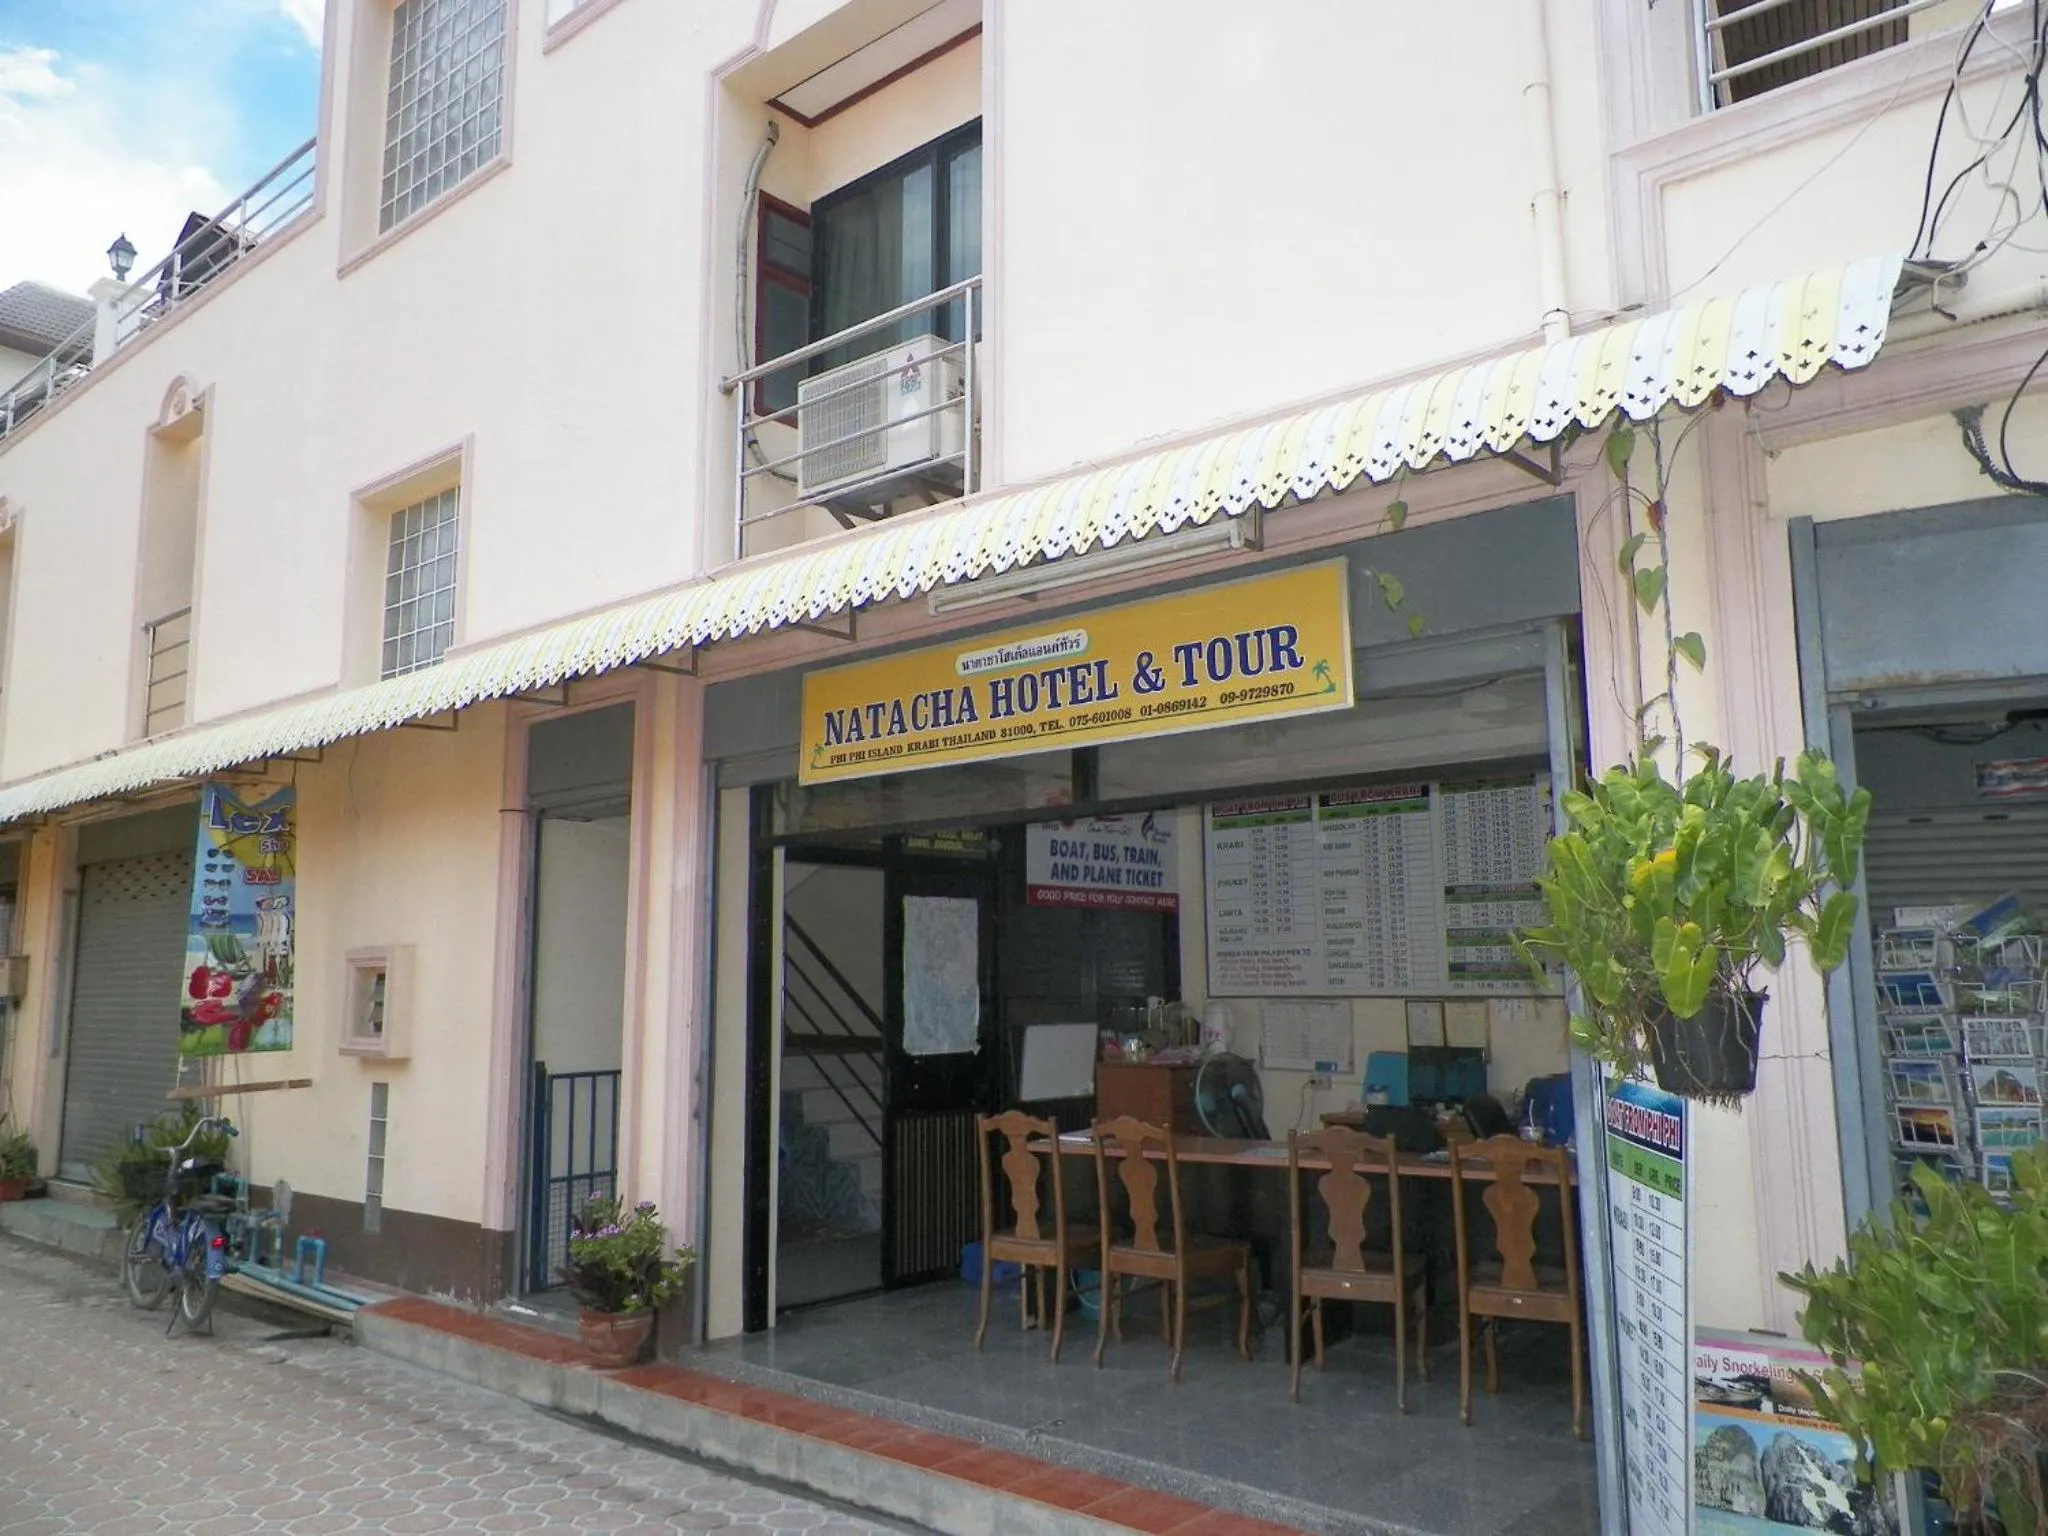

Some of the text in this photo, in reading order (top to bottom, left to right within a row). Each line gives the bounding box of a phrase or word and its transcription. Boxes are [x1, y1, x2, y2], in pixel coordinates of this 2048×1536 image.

[823, 624, 1304, 747] NATACHA HOTEL & TOUR
[830, 752, 847, 765] PHI
[849, 749, 866, 763] PHI
[867, 743, 904, 760] ISLAND
[906, 737, 940, 753] KRABI
[941, 728, 997, 748] THAILAND
[1039, 720, 1063, 732] TEL.
[1069, 707, 1132, 727] 075-601008
[1139, 696, 1207, 717] 01-0869142
[1219, 682, 1295, 704] 09-9729870
[1050, 839, 1162, 866] BOAT, BUS, TRAIN,
[1050, 862, 1164, 887] AND PLANE TICKET
[1037, 889, 1061, 901] GOOD
[1088, 892, 1104, 903] FOR
[1646, 1108, 1662, 1145] PHI
[1663, 1113, 1680, 1150] PHI
[1695, 1354, 1719, 1374] aily
